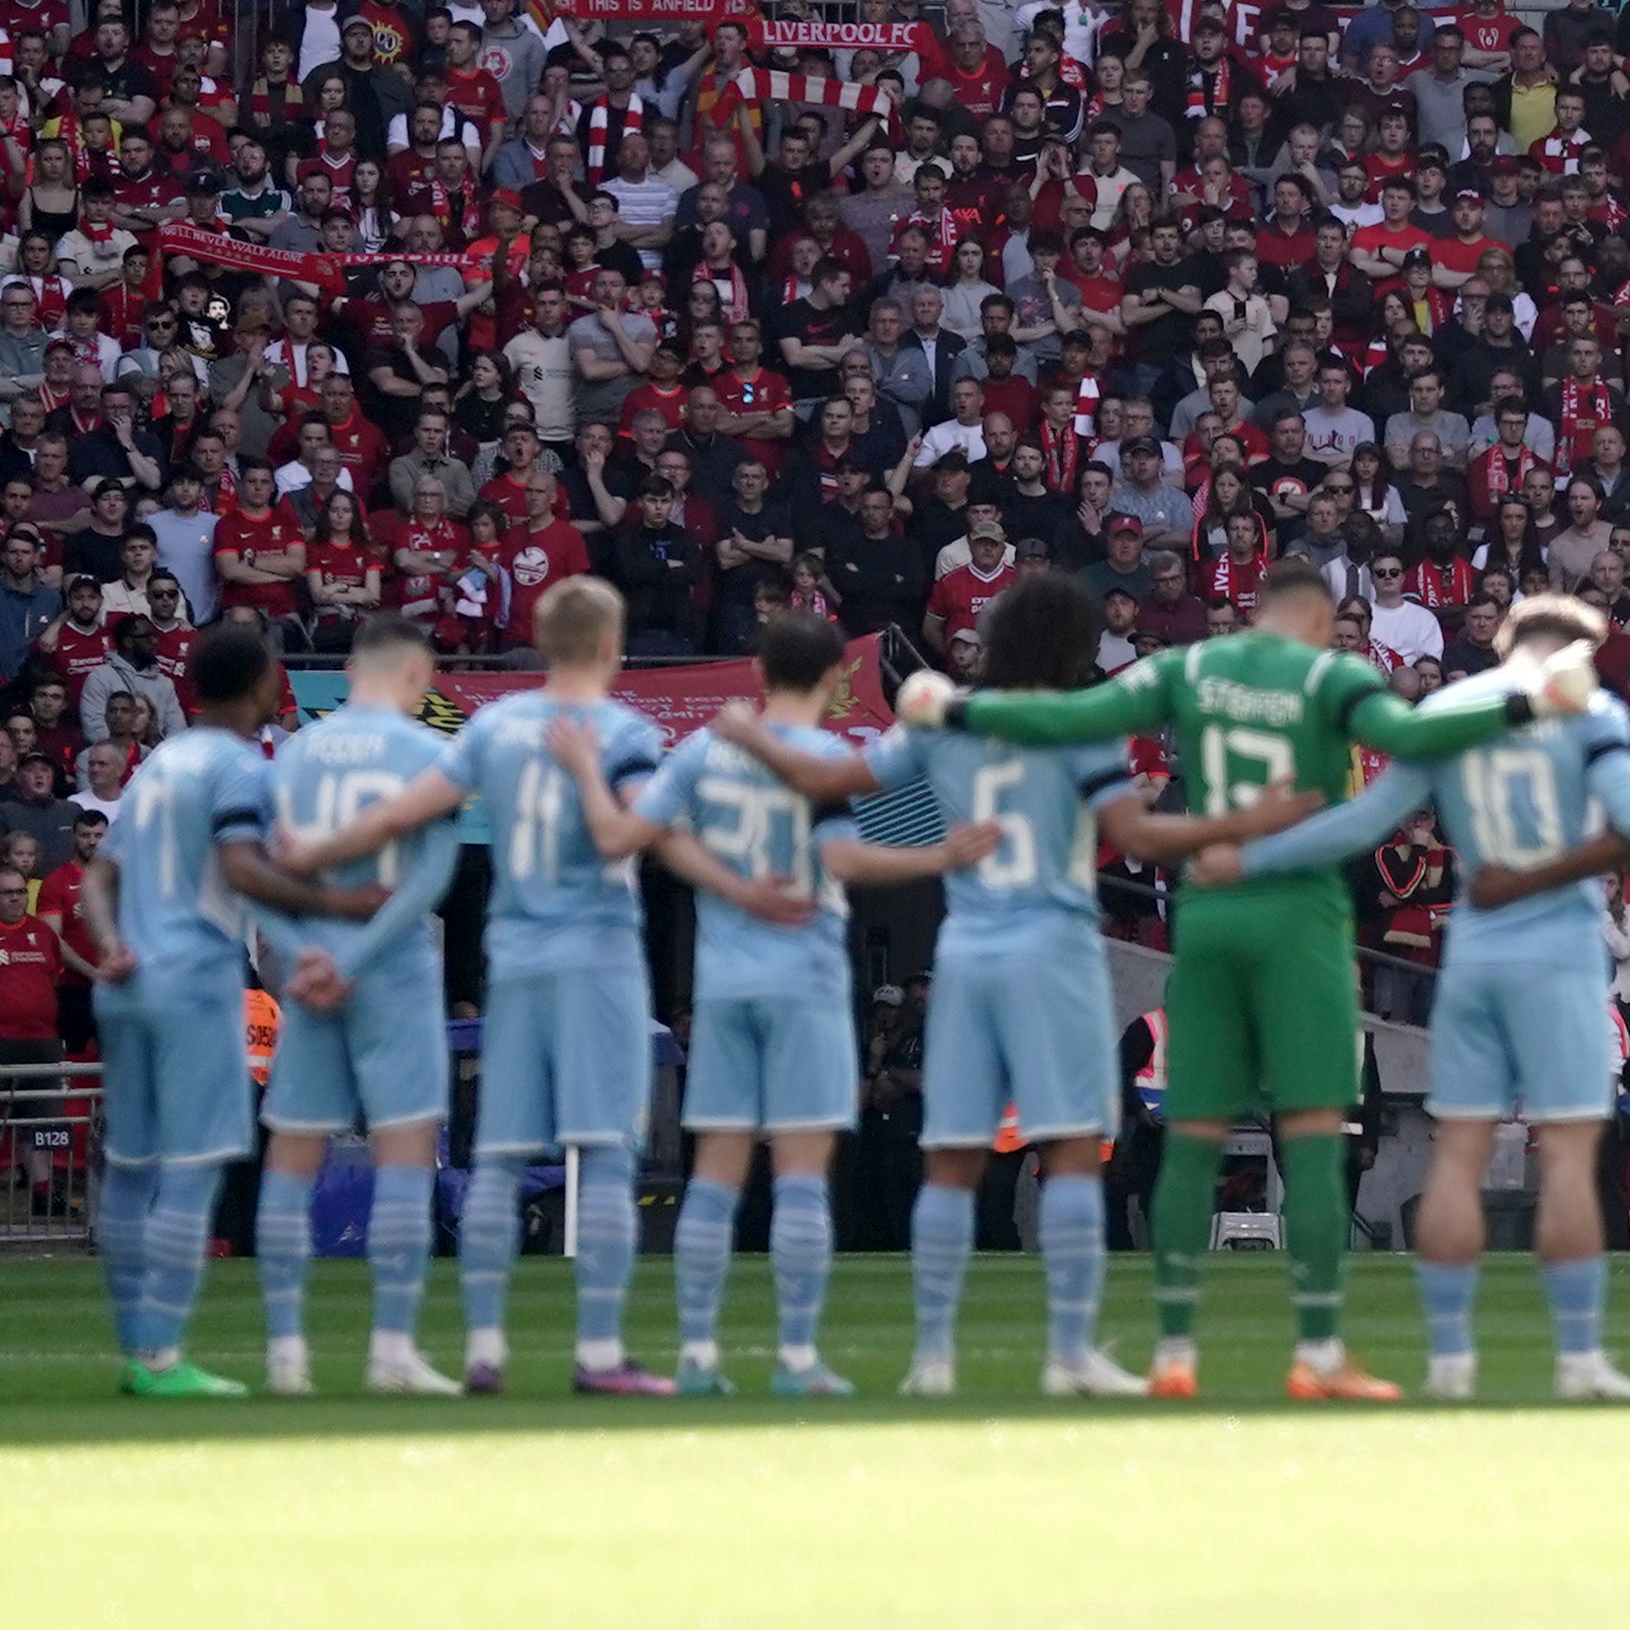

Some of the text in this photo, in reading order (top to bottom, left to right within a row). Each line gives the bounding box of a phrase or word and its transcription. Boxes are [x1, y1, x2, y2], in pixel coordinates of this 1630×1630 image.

[763, 20, 915, 44] LIVERPOOL FC
[512, 758, 564, 883] 11
[973, 761, 1037, 888] 6
[1463, 751, 1564, 866] 10
[34, 1132, 69, 1146] B128
